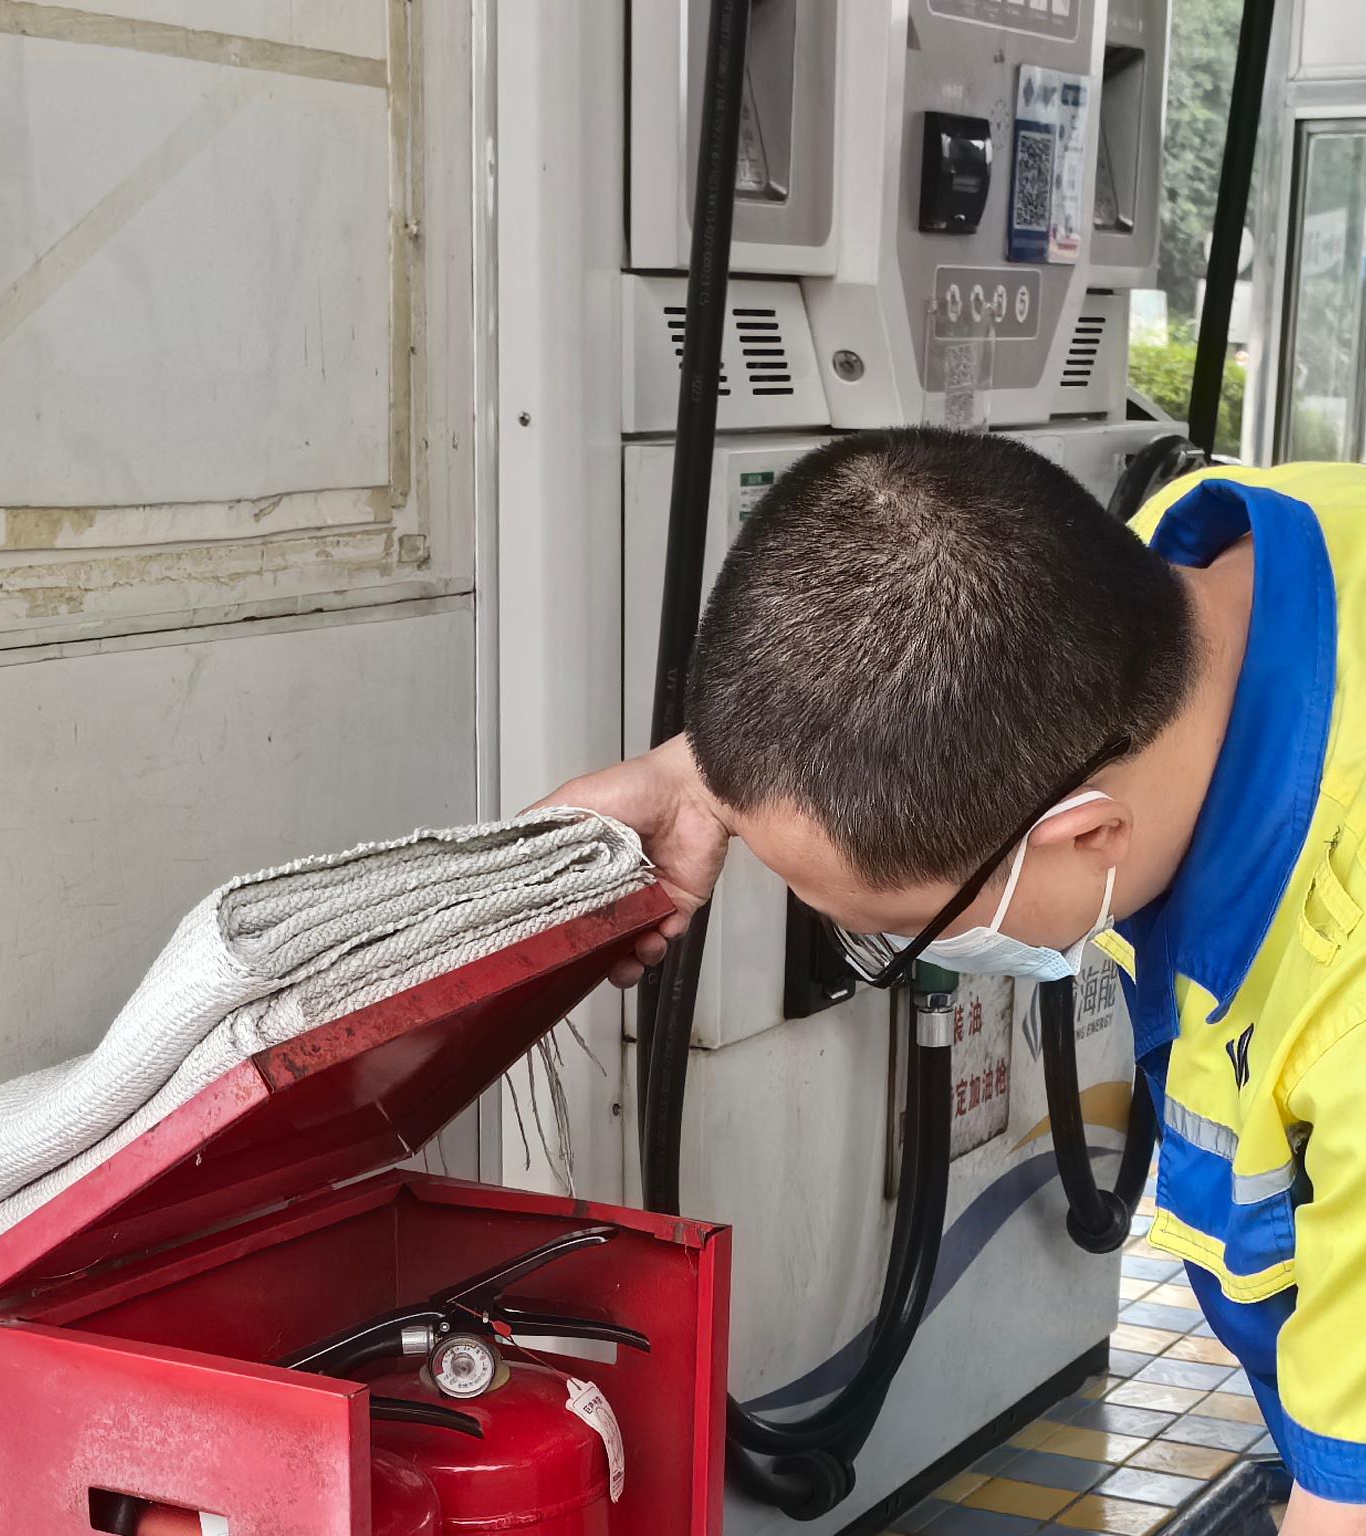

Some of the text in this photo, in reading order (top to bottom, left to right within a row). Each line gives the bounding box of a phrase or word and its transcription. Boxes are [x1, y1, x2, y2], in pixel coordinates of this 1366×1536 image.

[1073, 957, 1118, 1022] 海能
[952, 1057, 1007, 1118] 定加油枪
